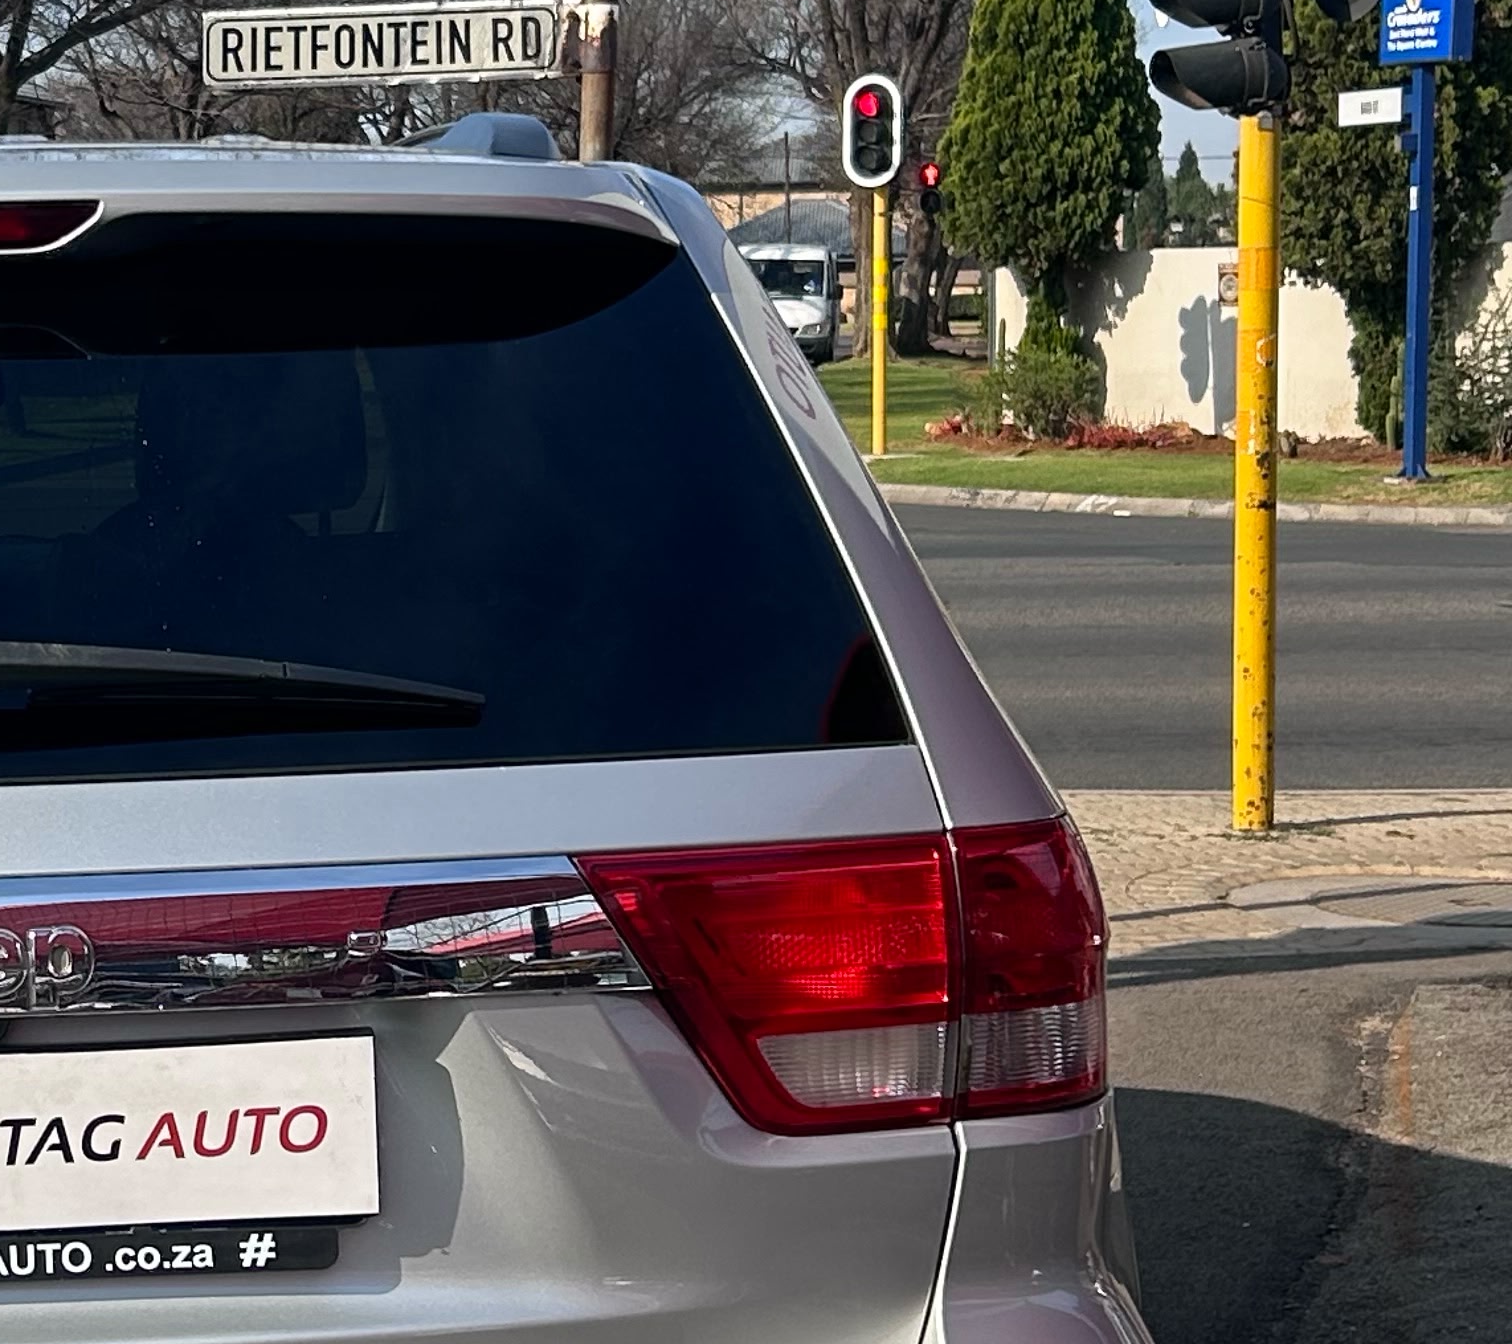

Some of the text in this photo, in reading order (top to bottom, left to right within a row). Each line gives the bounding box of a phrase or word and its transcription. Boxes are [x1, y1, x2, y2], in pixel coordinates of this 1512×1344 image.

[221, 16, 543, 74] RIETFONTEIN RD
[136, 1104, 328, 1160] AUTO
[104, 1242, 215, 1272] .co.za
